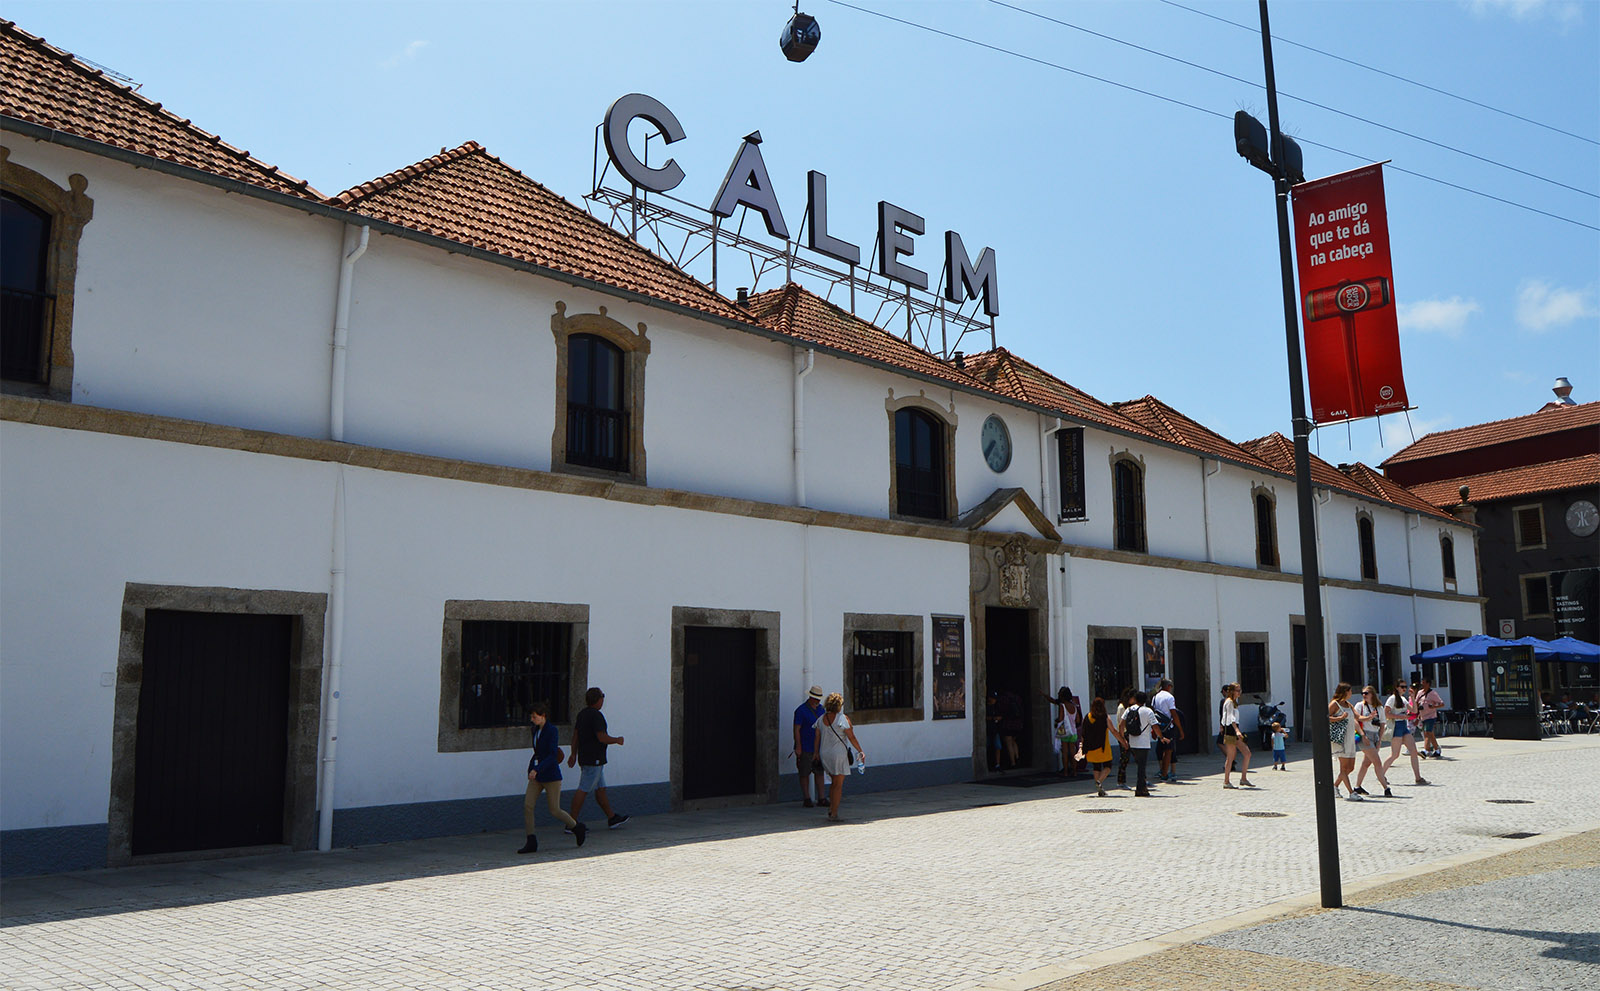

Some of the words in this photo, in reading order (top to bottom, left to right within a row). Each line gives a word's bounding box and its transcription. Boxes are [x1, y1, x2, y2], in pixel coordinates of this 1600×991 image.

[1309, 212, 1325, 228] Ao
[1328, 202, 1368, 222] amigo
[1309, 230, 1333, 250] que
[1336, 225, 1350, 240] te
[1353, 219, 1370, 236] dá
[1310, 252, 1326, 267] na
[1329, 241, 1374, 262] cabeça
[1345, 289, 1353, 308] BOCK
[1351, 286, 1360, 307] SUPER
